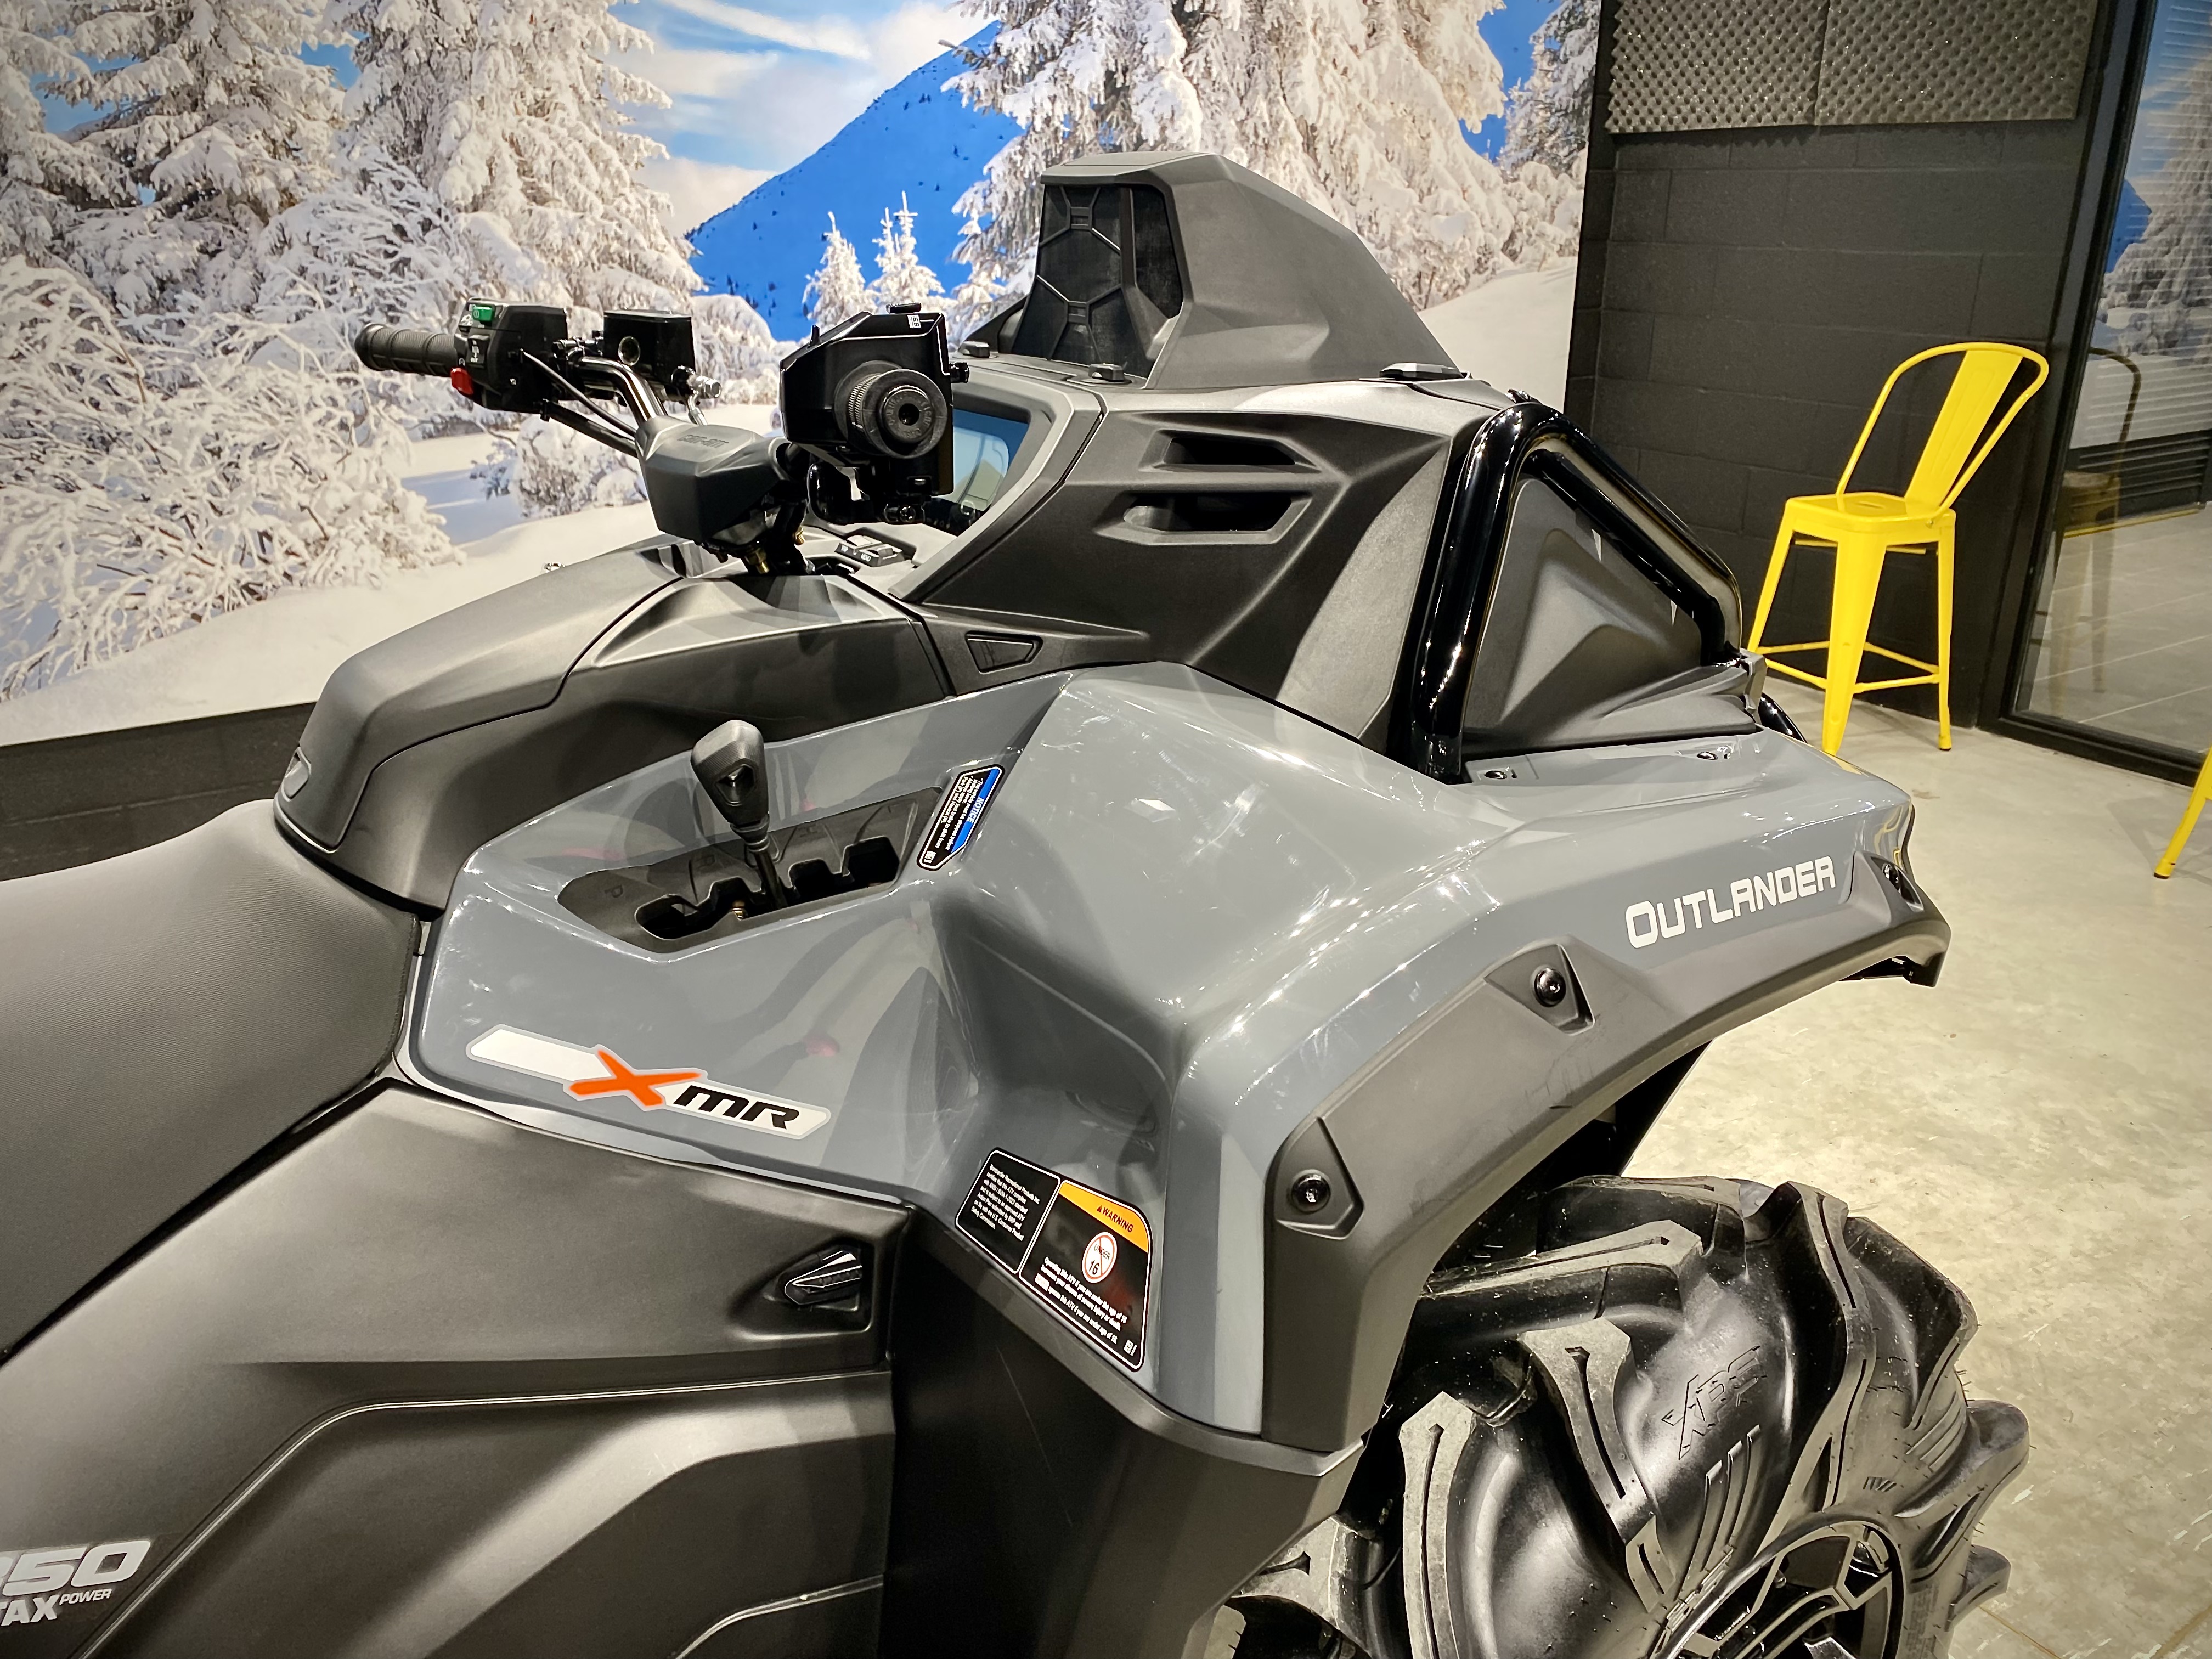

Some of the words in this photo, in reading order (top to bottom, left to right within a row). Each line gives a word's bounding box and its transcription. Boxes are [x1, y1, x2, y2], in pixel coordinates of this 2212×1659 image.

[967, 797, 985, 823] NOTICE
[1626, 856, 1836, 949] OUTLANDER
[1102, 1206, 1133, 1232] WARNING
[1093, 1244, 1111, 1261] UNDER
[1088, 1260, 1100, 1275] 16
[0, 1539, 151, 1596] 50
[59, 1588, 112, 1606] POWER
